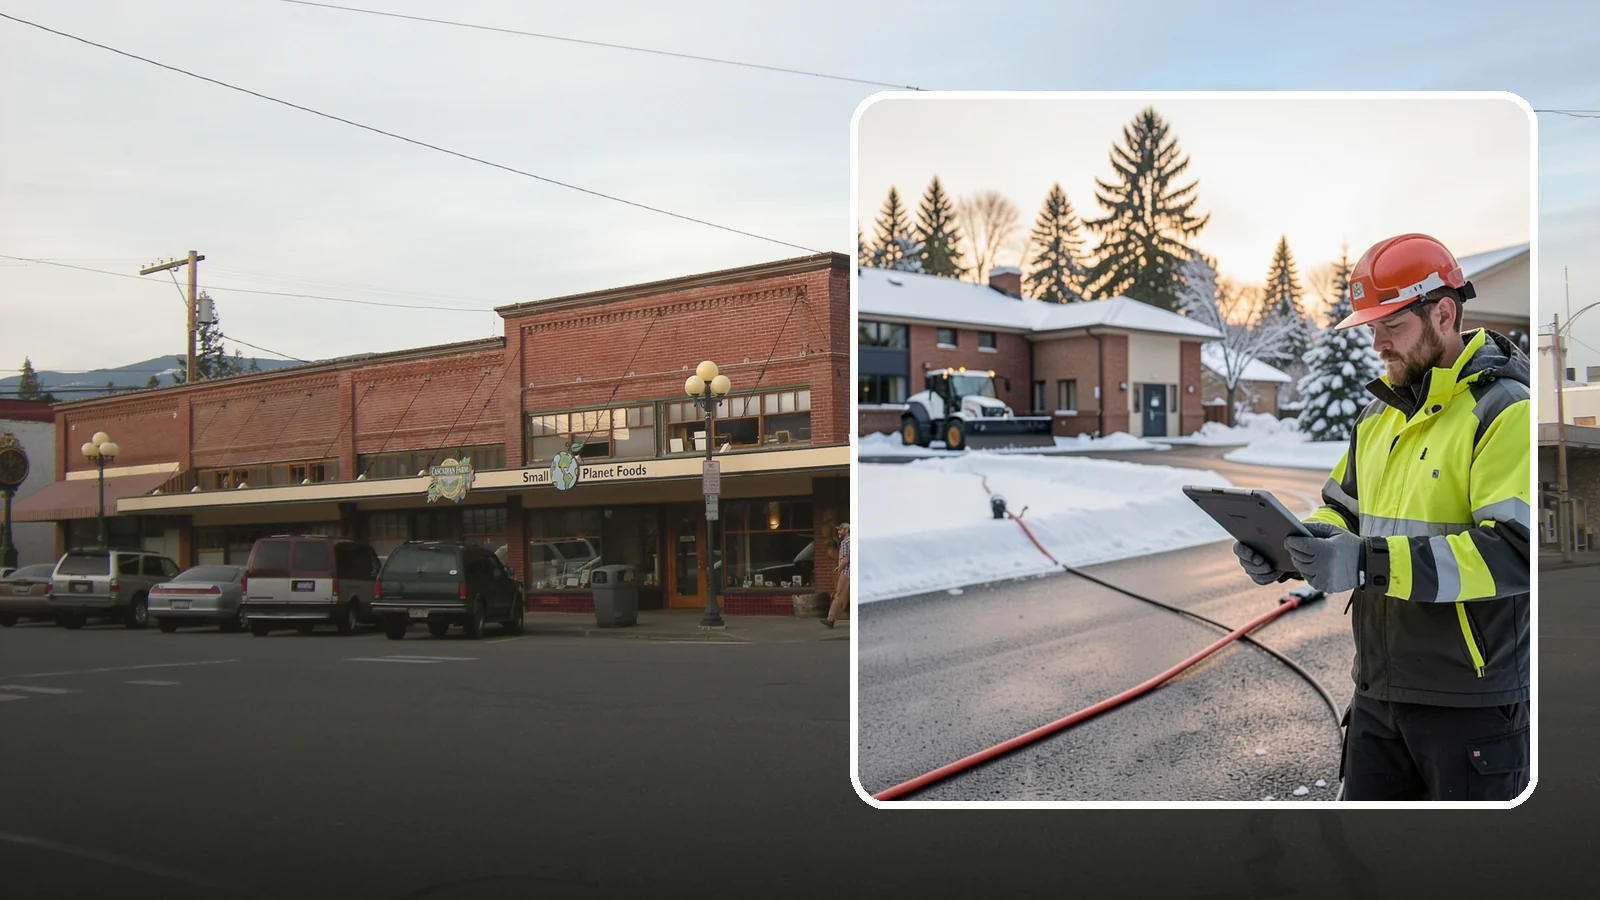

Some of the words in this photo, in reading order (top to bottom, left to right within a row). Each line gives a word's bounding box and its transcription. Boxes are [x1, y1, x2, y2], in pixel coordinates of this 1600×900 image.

[523, 471, 549, 483] Small
[582, 467, 614, 479] Planet
[616, 464, 647, 477] Foods
